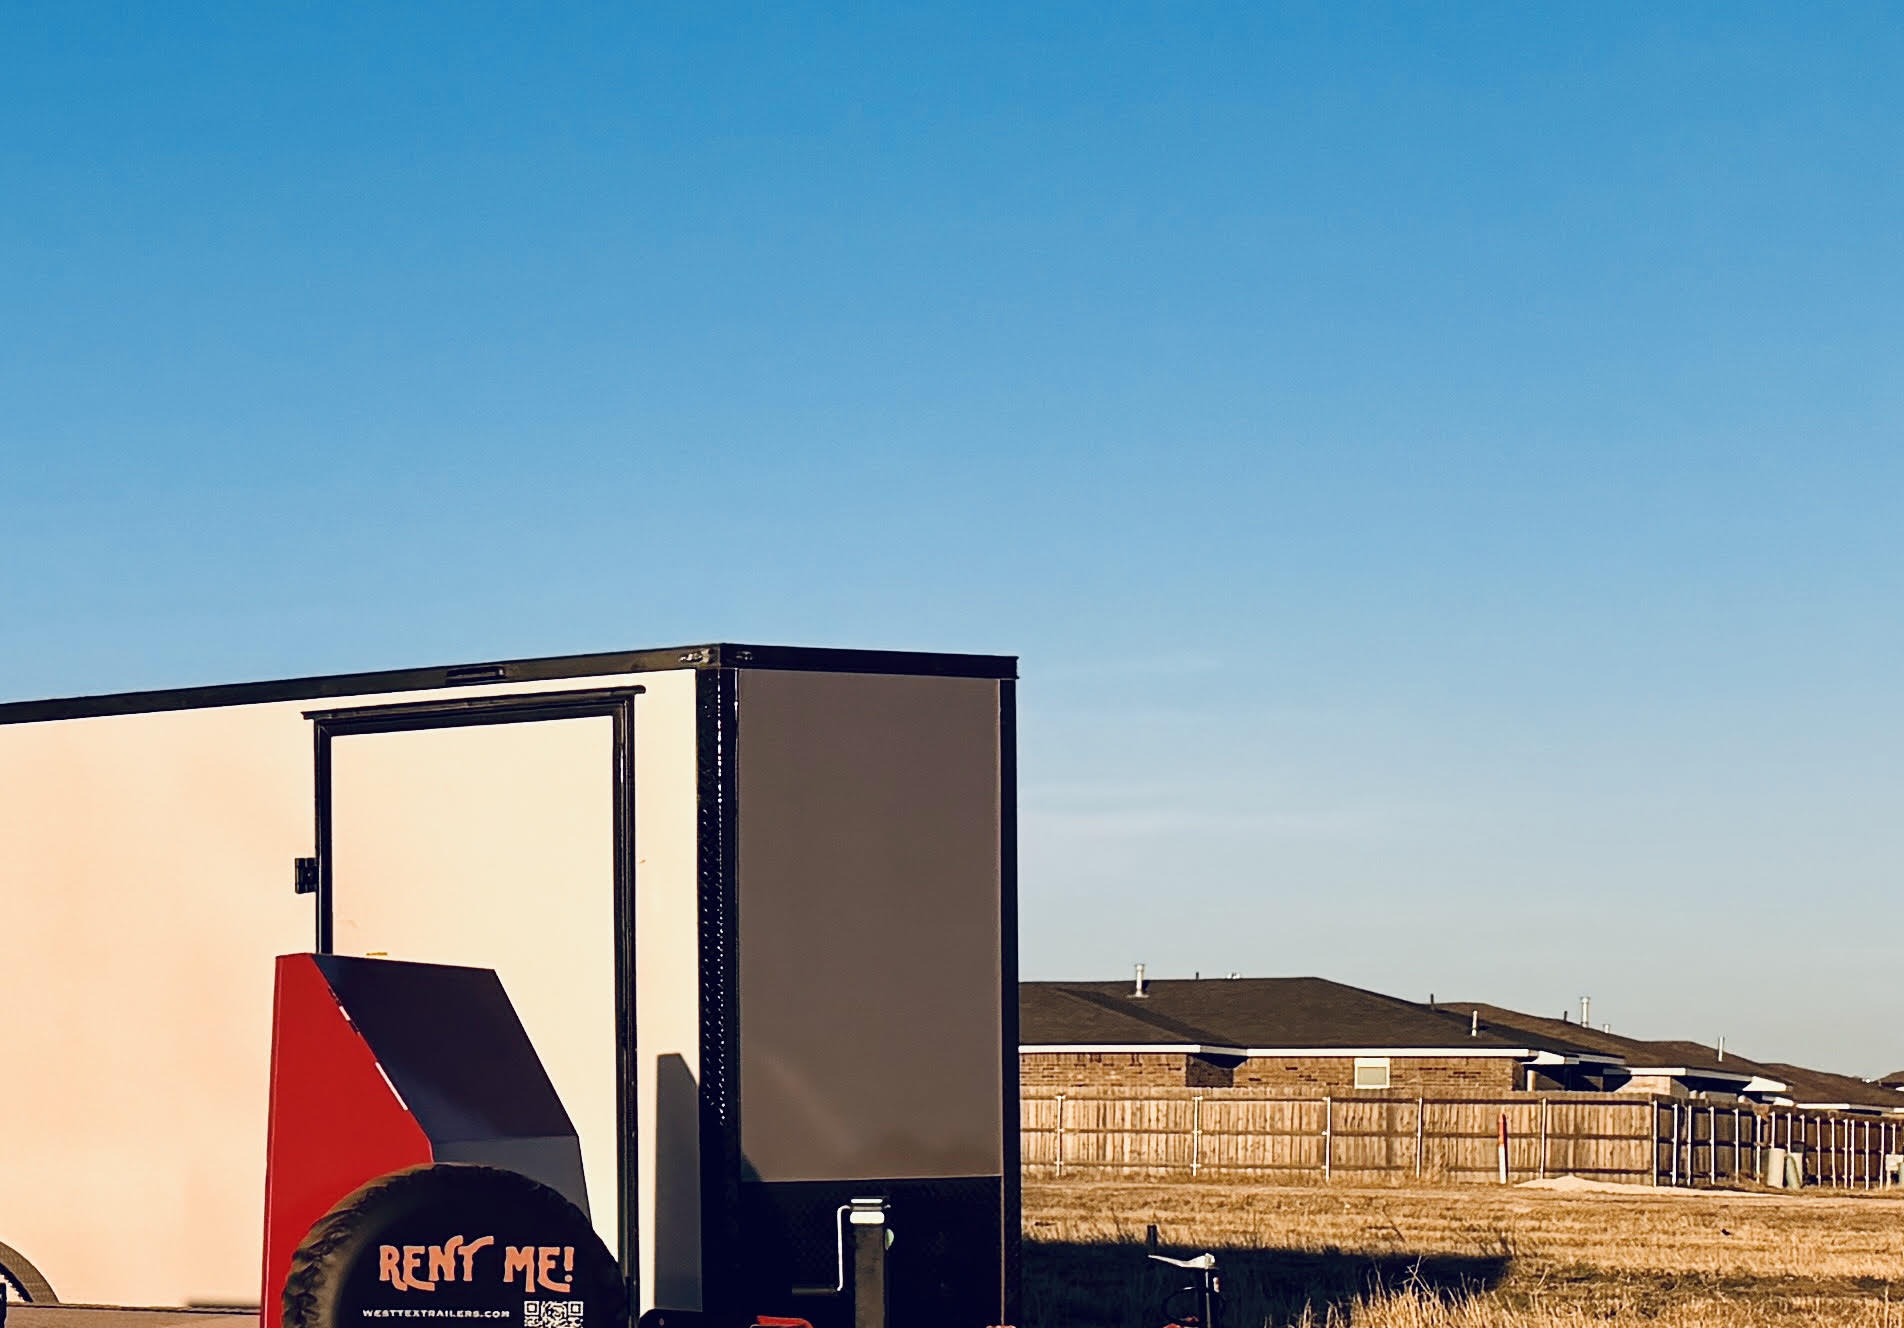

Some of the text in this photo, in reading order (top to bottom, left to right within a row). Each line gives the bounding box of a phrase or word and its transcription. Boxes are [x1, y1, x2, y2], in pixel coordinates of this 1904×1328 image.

[378, 1234, 575, 1293] RENT ME!
[362, 1308, 510, 1320] WESTTEXTRAILERS.COM
